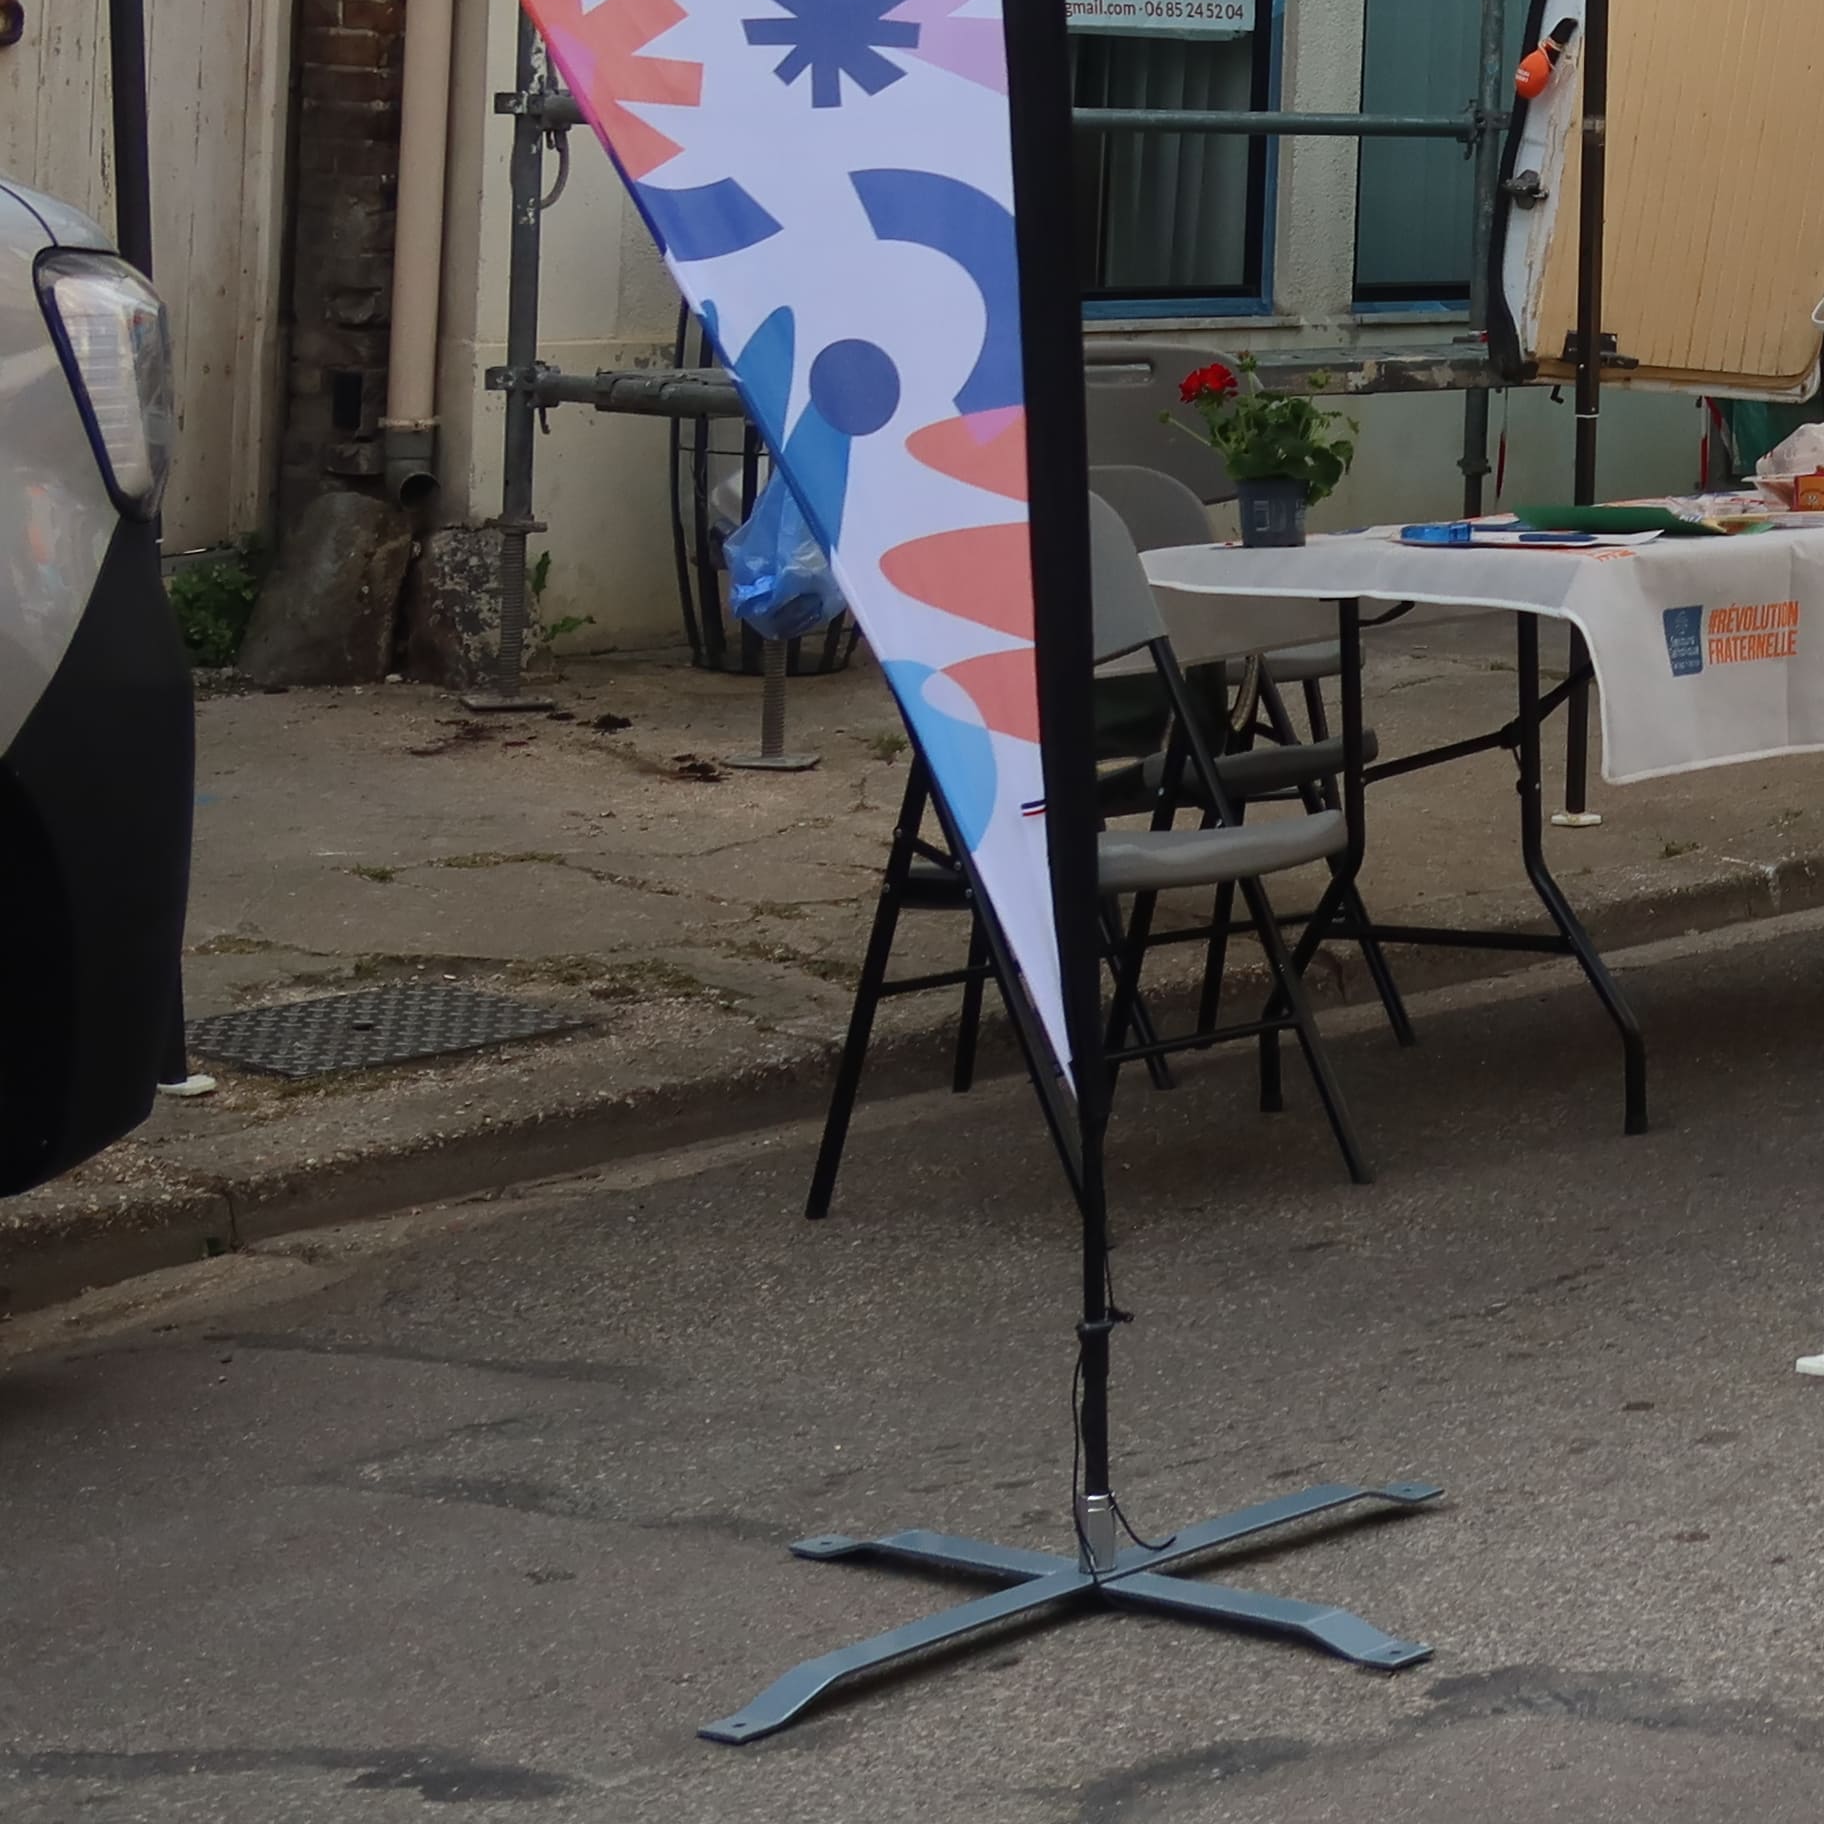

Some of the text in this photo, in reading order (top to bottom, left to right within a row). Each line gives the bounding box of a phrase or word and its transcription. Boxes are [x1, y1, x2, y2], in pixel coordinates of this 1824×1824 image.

[1165, 2, 1183, 18] 85
[1185, 2, 1204, 19] 24
[1206, 2, 1223, 20] 52
[1225, 3, 1243, 20] 04
[1708, 600, 1799, 634] #RÉVOLUTION
[1708, 629, 1799, 664] FRATERNELLE
